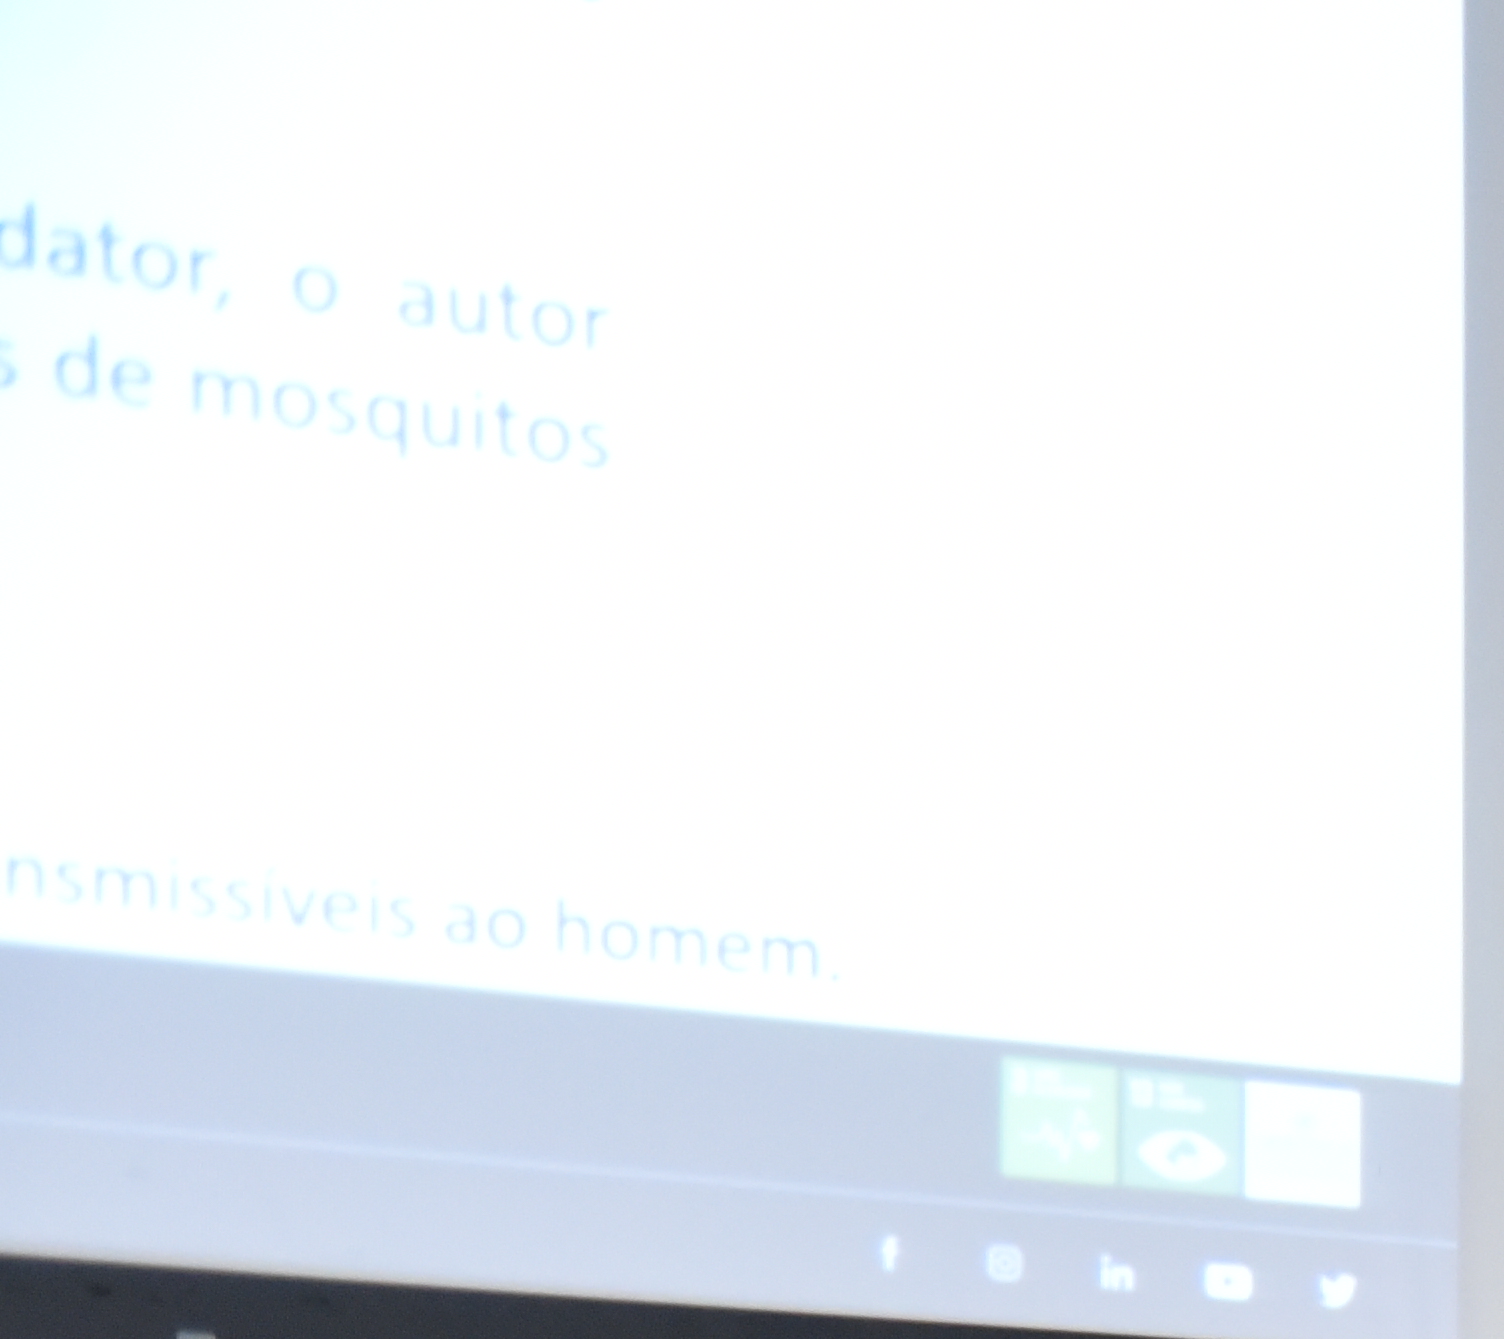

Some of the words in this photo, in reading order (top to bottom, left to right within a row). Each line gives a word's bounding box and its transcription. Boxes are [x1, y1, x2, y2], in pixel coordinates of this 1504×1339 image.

[291, 264, 340, 315] o
[398, 281, 609, 349] autor
[53, 334, 154, 407] de
[191, 367, 610, 468] mosquitos
[4, 853, 418, 940] nsmissíveis
[444, 902, 529, 951] ao
[556, 897, 841, 982] homem.
